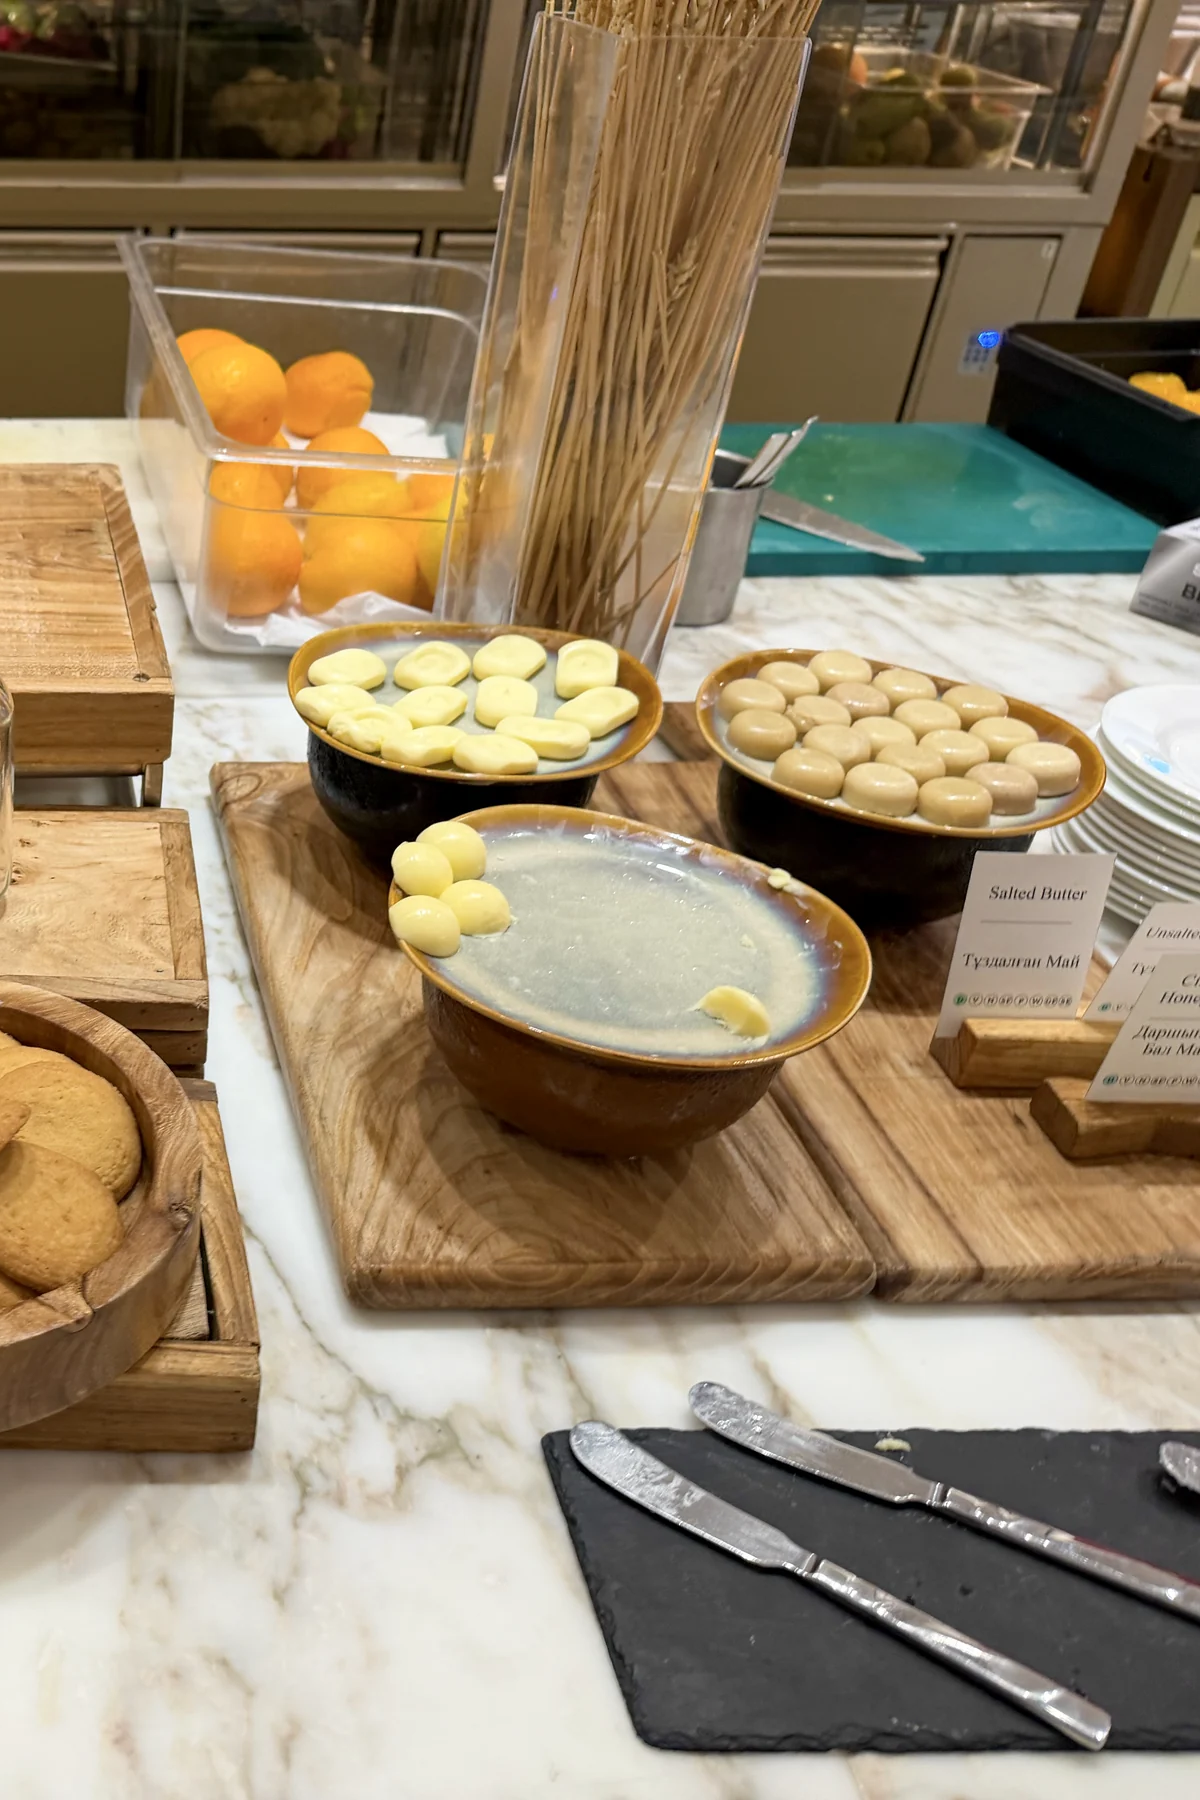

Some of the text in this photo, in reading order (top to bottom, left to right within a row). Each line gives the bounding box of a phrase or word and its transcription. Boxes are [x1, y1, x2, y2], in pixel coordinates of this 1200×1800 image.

[988, 886, 1088, 901] Salted Butter
[1046, 954, 1081, 969] Май
[1142, 1042, 1173, 1056] Бал
